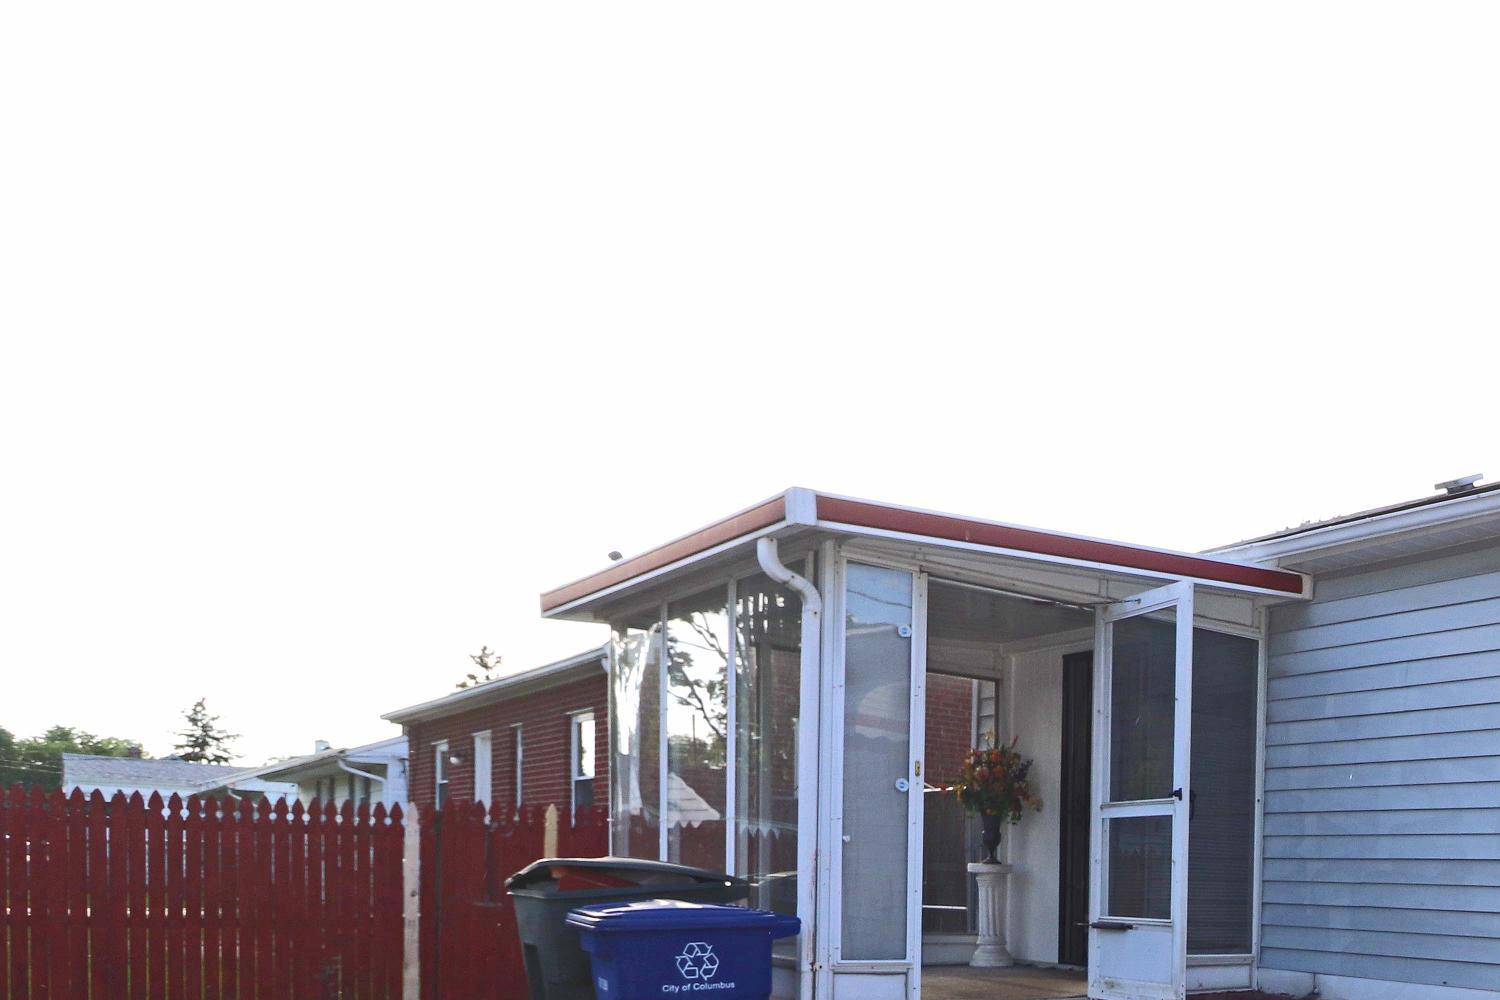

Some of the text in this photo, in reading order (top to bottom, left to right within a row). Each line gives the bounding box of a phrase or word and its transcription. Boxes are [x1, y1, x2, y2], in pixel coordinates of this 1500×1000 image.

[662, 981, 736, 993] City of Columbus
